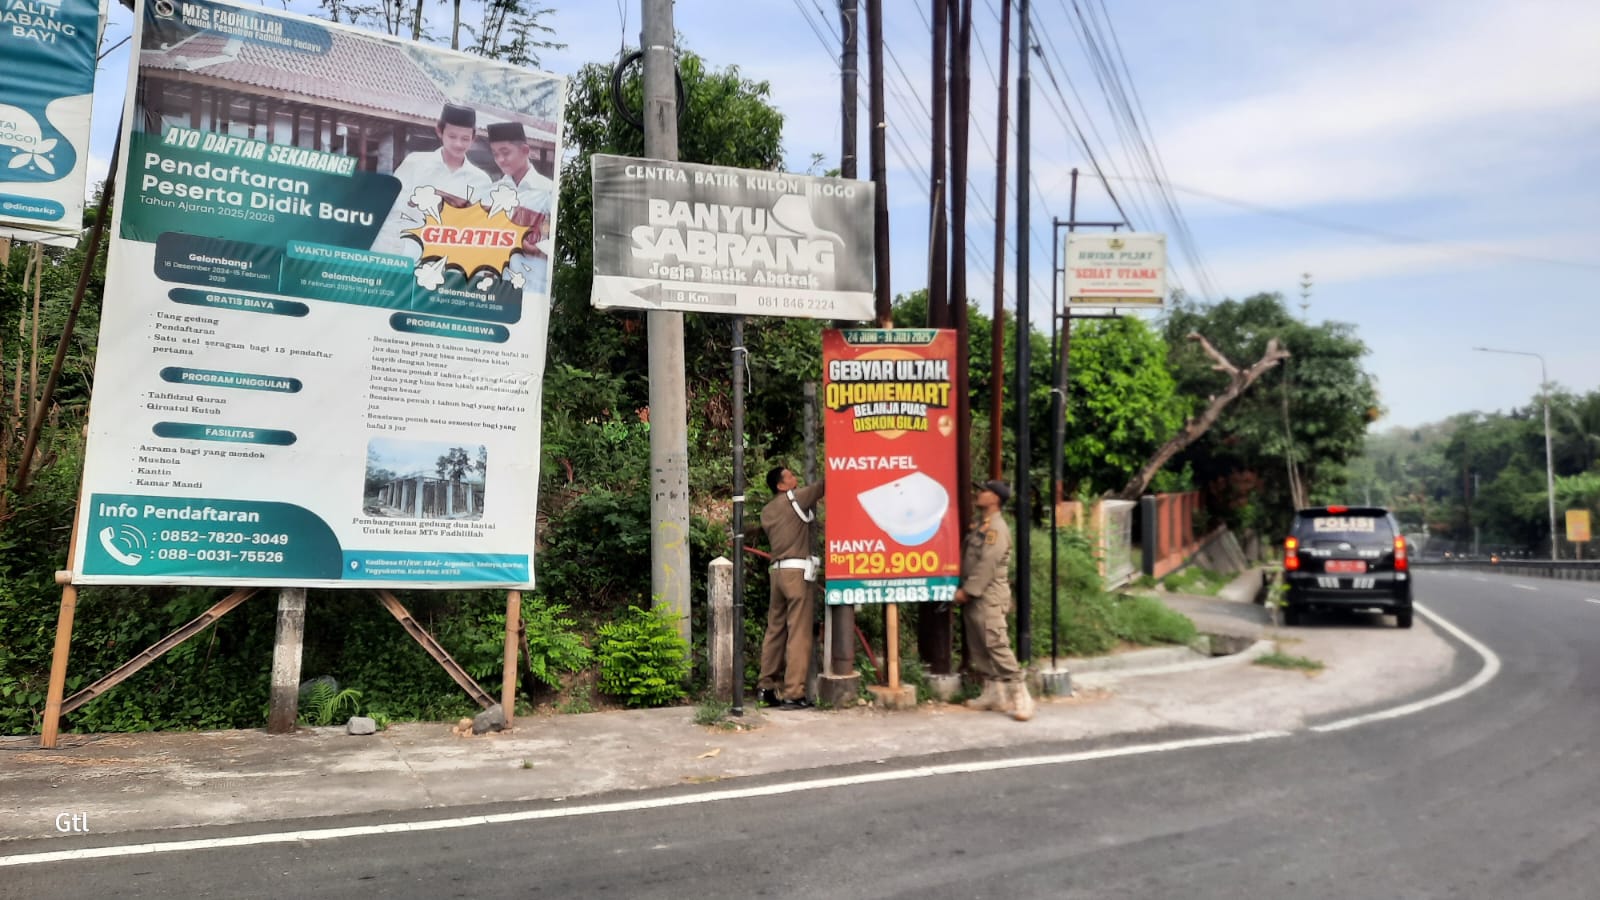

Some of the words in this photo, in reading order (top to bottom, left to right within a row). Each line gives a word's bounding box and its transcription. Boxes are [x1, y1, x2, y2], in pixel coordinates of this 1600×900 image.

[182, 3, 210, 20] MTs
[214, 9, 282, 36] FADHLILLAH
[13, 25, 56, 44] BAYI
[182, 16, 212, 29] Pondok
[214, 22, 253, 38] Pesantren
[294, 40, 320, 52] Sedayu
[166, 128, 200, 148] AYO
[202, 134, 266, 160] DAFTAR
[268, 146, 356, 174] SEKARANG!
[145, 153, 309, 195] Pendaftaran
[624, 164, 687, 182] CENTRA
[695, 171, 739, 188] BATIK
[746, 176, 798, 193] KULON
[805, 182, 856, 198] ROGO
[142, 174, 242, 206] Peserta
[251, 191, 312, 216] Didik
[318, 202, 373, 226] Baru
[3, 202, 56, 215] @dinparkp
[140, 194, 175, 208] Tahun
[178, 200, 214, 216] Ajaran
[218, 206, 275, 223] 2025/2026
[648, 198, 767, 234] BANYU
[423, 227, 515, 247] GRATIS
[294, 244, 332, 258] WAKTU
[334, 251, 408, 268] PENDAFTARAN
[631, 226, 834, 273] SABRANG
[188, 253, 248, 270] Gelombang
[249, 260, 252, 268] I
[322, 272, 375, 286] Gelombang
[648, 262, 694, 280] Jogja
[701, 267, 747, 283] Batik
[753, 270, 819, 288] Abstrak
[206, 294, 242, 306] GRATIS
[244, 298, 274, 310] BIAYA
[438, 287, 486, 302] Gelombang
[676, 292, 684, 301] 8
[688, 292, 710, 304] Km
[758, 296, 778, 306] 081
[808, 299, 834, 310] 2224
[157, 312, 182, 322] Uang
[184, 315, 219, 326] gedung
[406, 318, 450, 330] PROGRAM
[451, 324, 494, 336] BEASISWA
[156, 323, 215, 335] Pendaftaran
[152, 346, 194, 356] pertama
[154, 334, 176, 342] Satu
[182, 336, 200, 344] stel
[204, 341, 245, 350] seragam
[250, 343, 270, 353] bagi
[290, 348, 334, 358] pendaftar
[830, 360, 894, 380] GEBYAR
[896, 360, 949, 380] ULTAH
[182, 372, 234, 384] PROGRAM
[235, 377, 290, 390] UNGGULAN
[196, 396, 227, 404] Quran
[826, 382, 950, 410] QHOMEMART
[191, 406, 220, 414] Kutub
[854, 402, 900, 418] BELANJA
[900, 402, 927, 416] PUAS
[853, 416, 896, 432] DISKON
[896, 416, 928, 432] GILAA
[205, 428, 254, 438] FASILITAS
[140, 444, 177, 454] Asrama
[180, 447, 200, 456] bagi
[203, 450, 226, 458] yang
[228, 450, 265, 458] mondok
[138, 456, 180, 465] Mushola
[829, 456, 918, 470] WASTAFEL
[137, 468, 172, 476] Kantin
[136, 479, 170, 488] Kamar
[172, 480, 202, 488] Mandi
[99, 502, 138, 518] Info
[144, 504, 259, 522] Pendaftaran
[352, 518, 417, 527] Pembangunan
[420, 521, 451, 529] gedung
[1314, 517, 1375, 532] POLISI
[160, 530, 288, 545] 0852-7820-3049
[440, 529, 484, 538] Fadhlillah
[830, 539, 886, 552] HANYA
[158, 548, 284, 562] 088-0031-75526
[830, 550, 939, 574] Rp129.900
